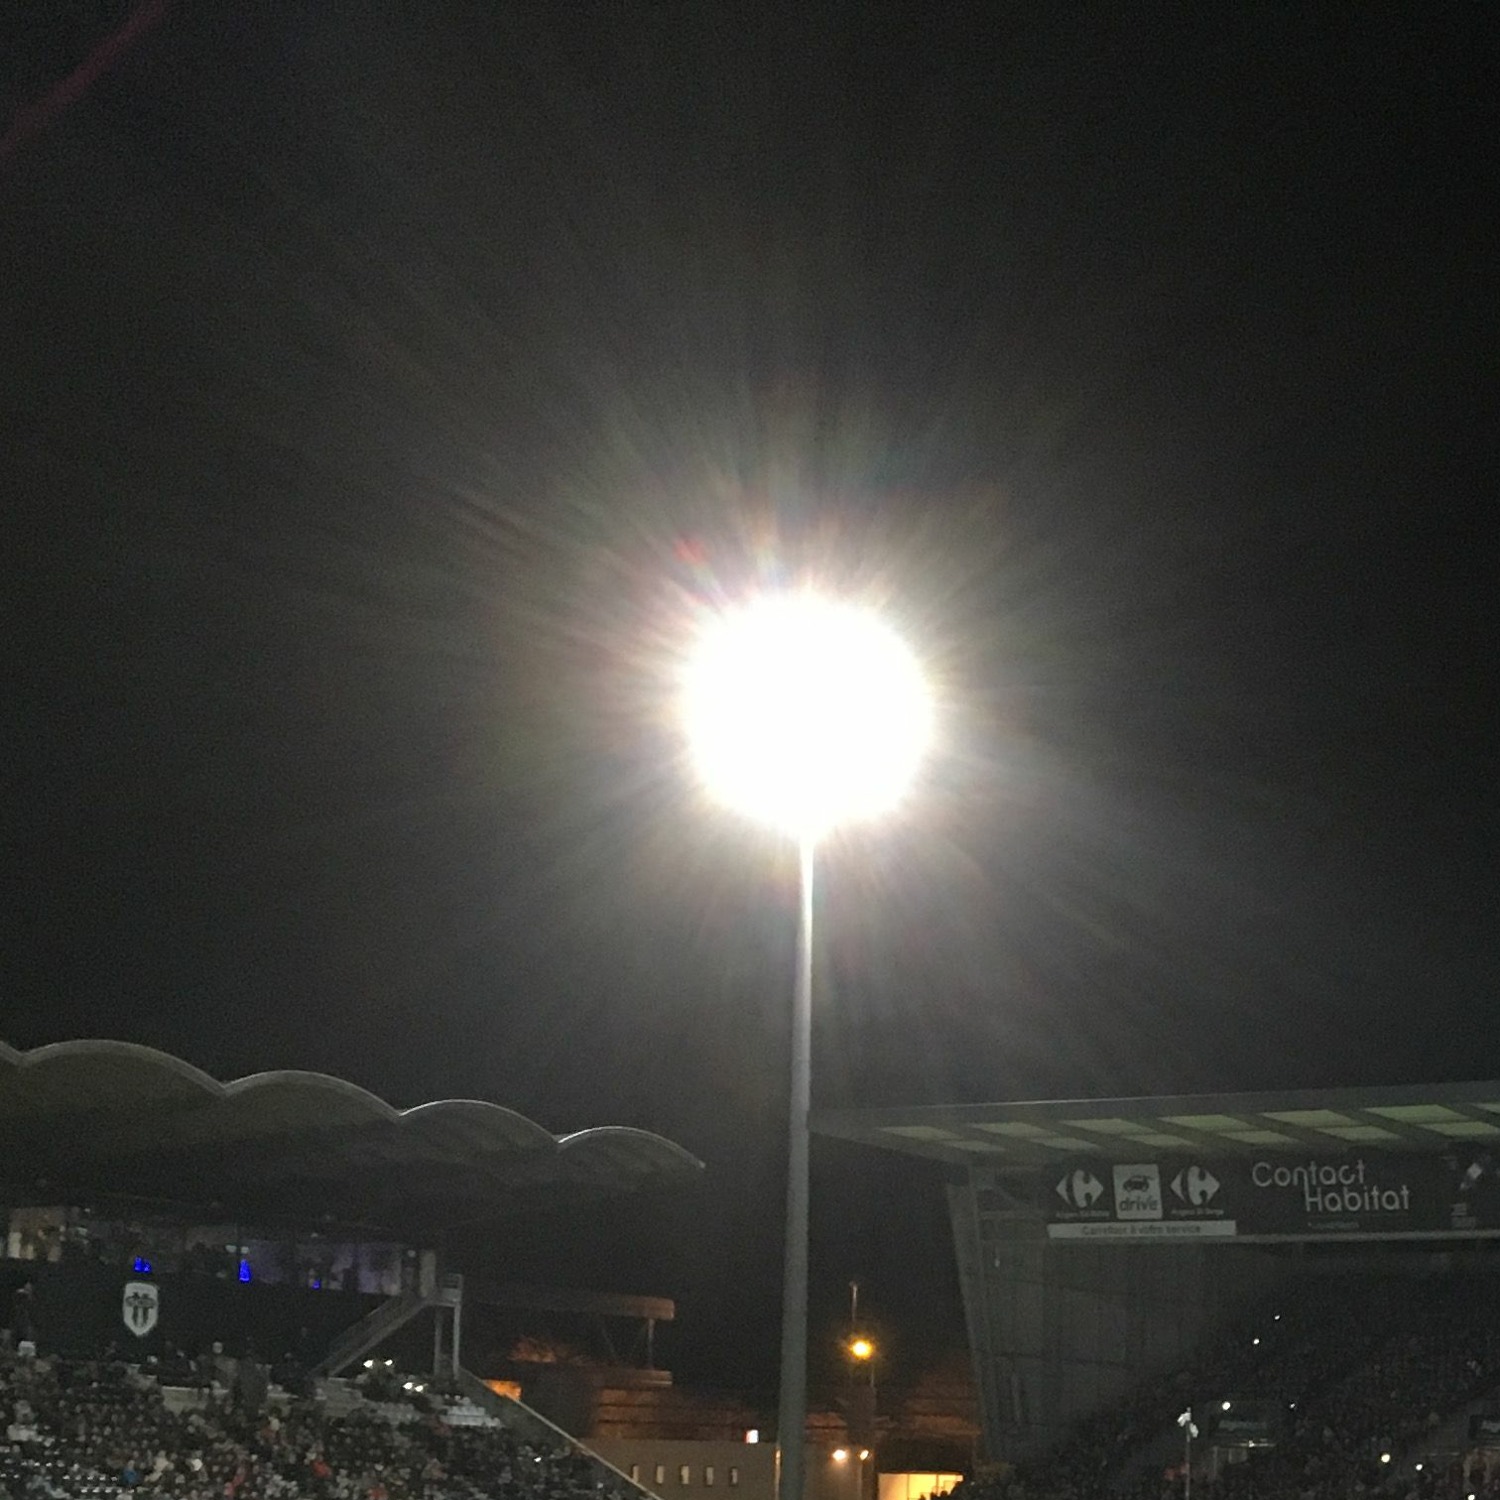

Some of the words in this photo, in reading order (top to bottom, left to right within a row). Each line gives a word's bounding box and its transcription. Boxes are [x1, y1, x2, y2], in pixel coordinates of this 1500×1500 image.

[1252, 1159, 1364, 1187] Contact
[1118, 1196, 1159, 1212] drive
[1304, 1184, 1410, 1212] Habitat
